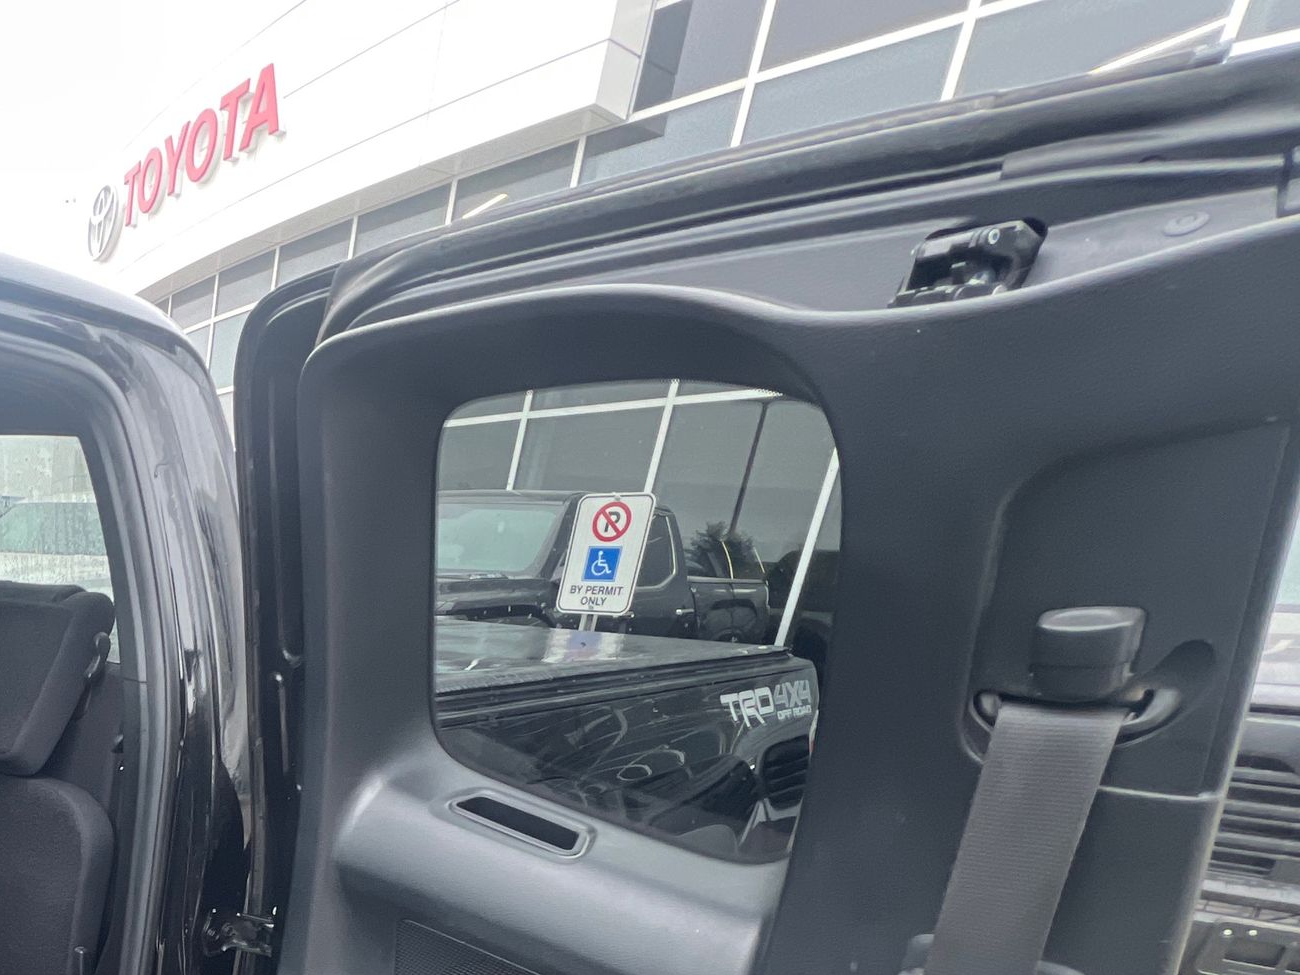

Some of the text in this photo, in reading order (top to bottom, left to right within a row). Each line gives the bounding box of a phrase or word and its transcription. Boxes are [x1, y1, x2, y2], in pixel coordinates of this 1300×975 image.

[124, 63, 280, 227] TOYOTA
[570, 585, 624, 595] BY PERMIT
[580, 596, 607, 606] ONLY
[720, 686, 774, 728] TRD
[777, 709, 792, 720] OFF
